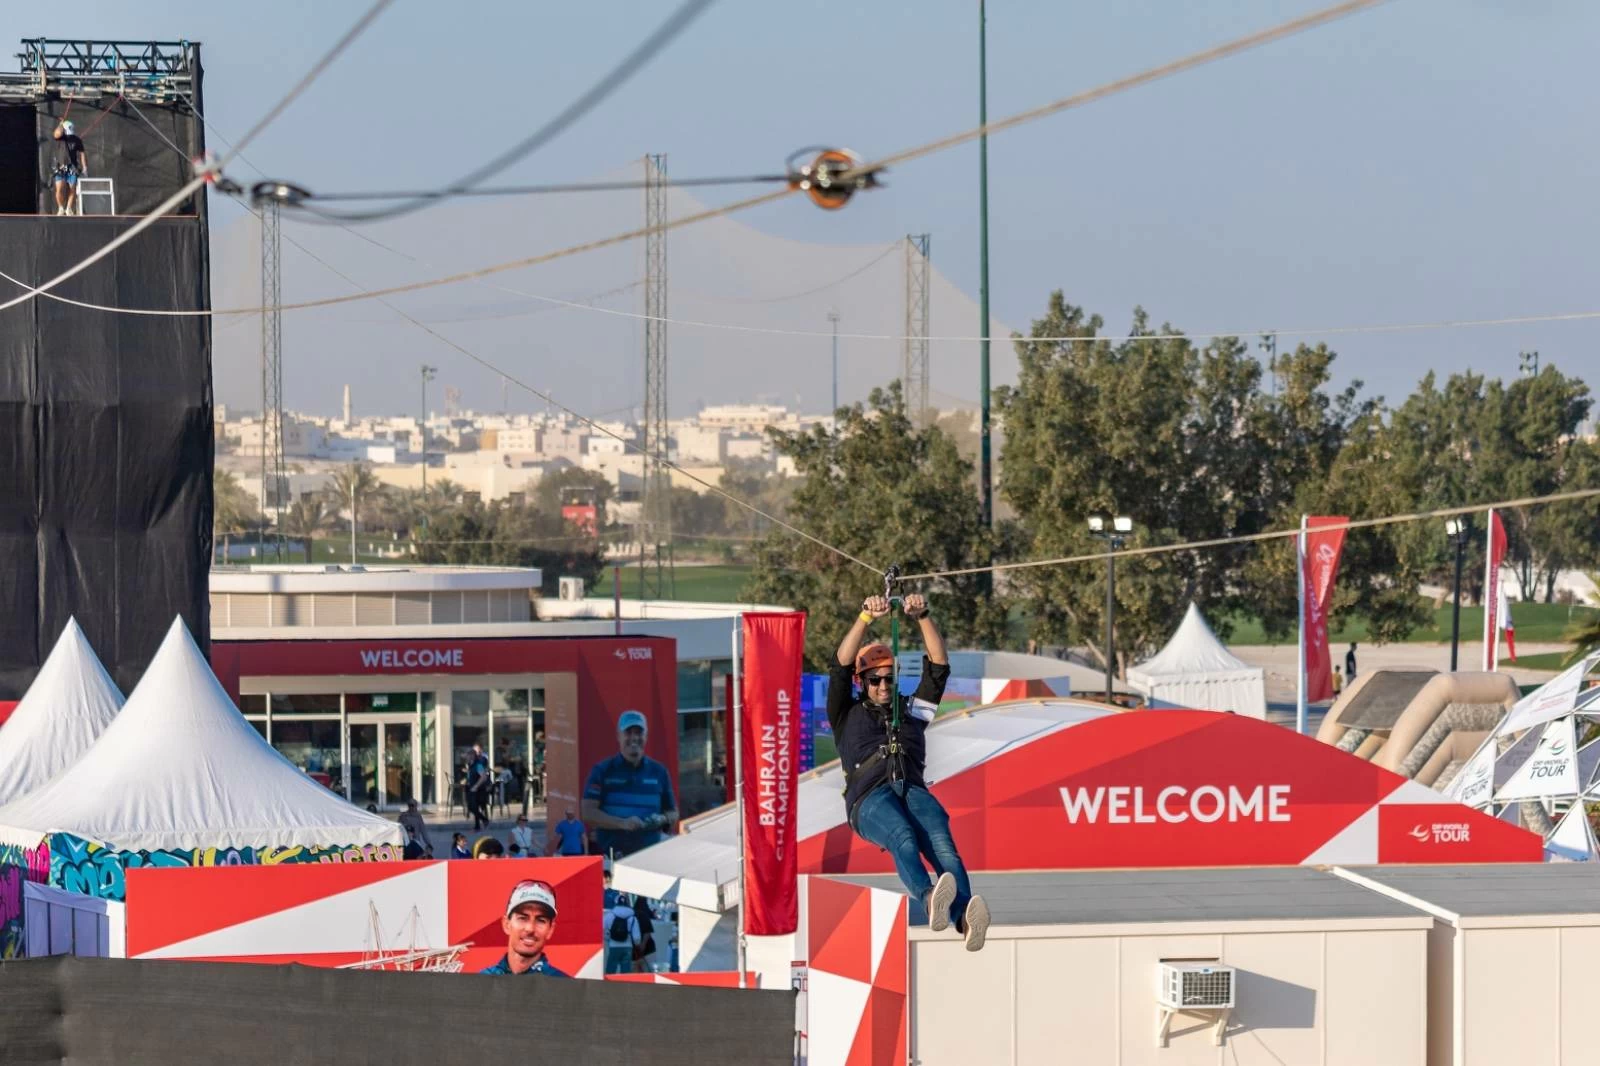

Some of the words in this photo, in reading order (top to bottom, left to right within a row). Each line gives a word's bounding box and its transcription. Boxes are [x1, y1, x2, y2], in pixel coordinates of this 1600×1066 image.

[360, 648, 464, 668] WELCOME
[759, 725, 776, 826] BAHRAIN
[776, 689, 791, 862] CHAMPIONSHIP
[1529, 764, 1566, 780] TOUR
[1058, 784, 1292, 824] WELCOME
[1432, 830, 1470, 844] TOUR
